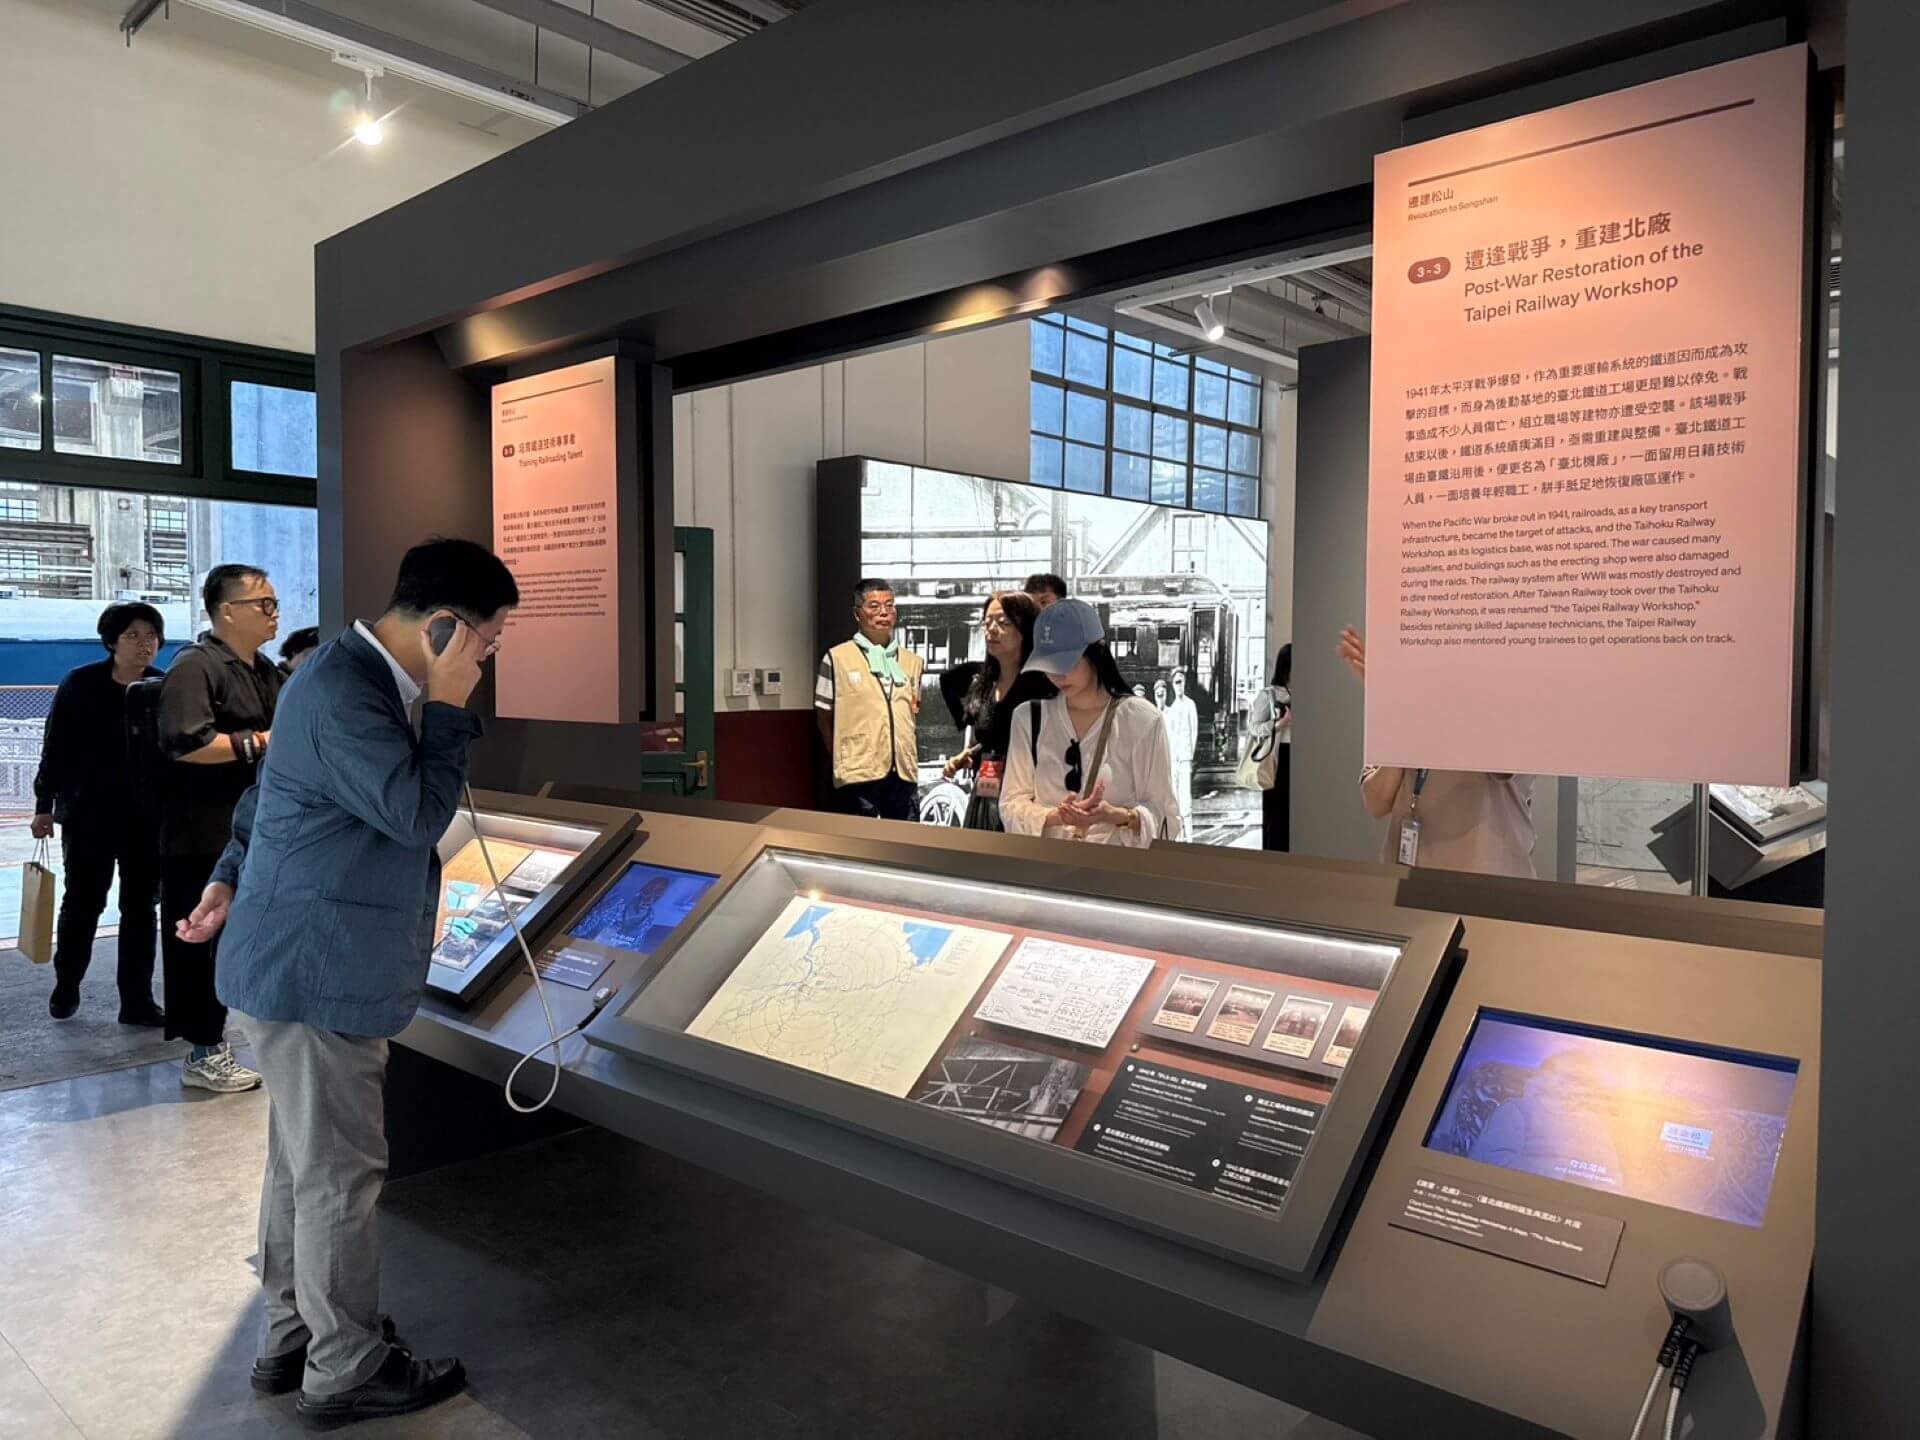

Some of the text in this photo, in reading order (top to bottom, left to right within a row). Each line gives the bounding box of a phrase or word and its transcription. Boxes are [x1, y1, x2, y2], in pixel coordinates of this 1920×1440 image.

[1465, 212, 1671, 271] 遭逢戰爭，重建北廠
[1464, 242, 1704, 297] Post-War Restoration of the
[1464, 275, 1678, 322] Taipei Railway Workshop
[1403, 521, 1426, 530] When
[1428, 520, 1441, 528] the
[1444, 518, 1471, 527] Pacific
[1473, 516, 1490, 525] War
[1493, 514, 1519, 523] broke
[1520, 513, 1535, 522] out
[1639, 504, 1657, 515] key
[1659, 501, 1708, 512] transport
[1462, 531, 1497, 540] became
[1499, 530, 1513, 538] the
[1516, 528, 1543, 538] target
[1595, 522, 1614, 532] and
[1616, 522, 1631, 531] the
[1635, 520, 1673, 530] Taihoku
[1676, 517, 1716, 527] Railway
[1459, 548, 1469, 556] its
[1471, 546, 1508, 556] logistics
[1535, 543, 1553, 551] was
[1555, 541, 1571, 550] not
[1611, 538, 1629, 547] The
[1632, 538, 1650, 546] war
[1652, 535, 1689, 545] caused
[1691, 533, 1721, 544] many
[1446, 563, 1462, 571] and
[1464, 560, 1505, 571] buildings
[1507, 559, 1528, 568] such
[1543, 558, 1558, 567] the
[1560, 556, 1600, 566] erecting
[1602, 555, 1627, 565] shop
[1629, 554, 1653, 562] were
[1655, 552, 1676, 561] also
[1678, 550, 1729, 561] damaged
[1401, 578, 1428, 589] during
[1430, 577, 1443, 586] the
[1470, 576, 1487, 585] The
[1489, 575, 1519, 585] railway
[1522, 574, 1555, 584] system
[1557, 573, 1579, 582] after
[1581, 571, 1606, 581] WWII
[1609, 572, 1627, 580] was
[1629, 568, 1664, 579] mostly
[1665, 567, 1718, 579] destroyed
[1720, 566, 1741, 576] and
[1410, 592, 1426, 601] dire
[1428, 592, 1448, 600] need
[1512, 590, 1536, 599] After
[1538, 589, 1569, 598] Taiwan
[1572, 588, 1609, 598] Railway
[1609, 586, 1632, 595] took
[1634, 586, 1656, 595] over
[1658, 585, 1675, 594] the
[1678, 584, 1719, 594] Taihoku
[1400, 608, 1432, 617] Railway
[1507, 604, 1548, 613] renamed
[1572, 603, 1600, 614] Taipei
[1602, 602, 1639, 612] Railway
[1400, 622, 1433, 630] Besides
[1434, 621, 1472, 631] retaining
[1474, 620, 1502, 629] skilled
[1503, 620, 1547, 630] Japanese
[1607, 618, 1624, 627] the
[1625, 617, 1655, 628] Taipei
[1657, 617, 1696, 628] Railway
[1400, 637, 1442, 646] Workshop
[1444, 636, 1461, 645] also
[1463, 635, 1506, 645] mentored
[1507, 636, 1536, 646] young
[1538, 635, 1575, 644] trainees
[1589, 635, 1605, 646] get
[1607, 634, 1661, 645] operations
[1663, 633, 1688, 643] back
